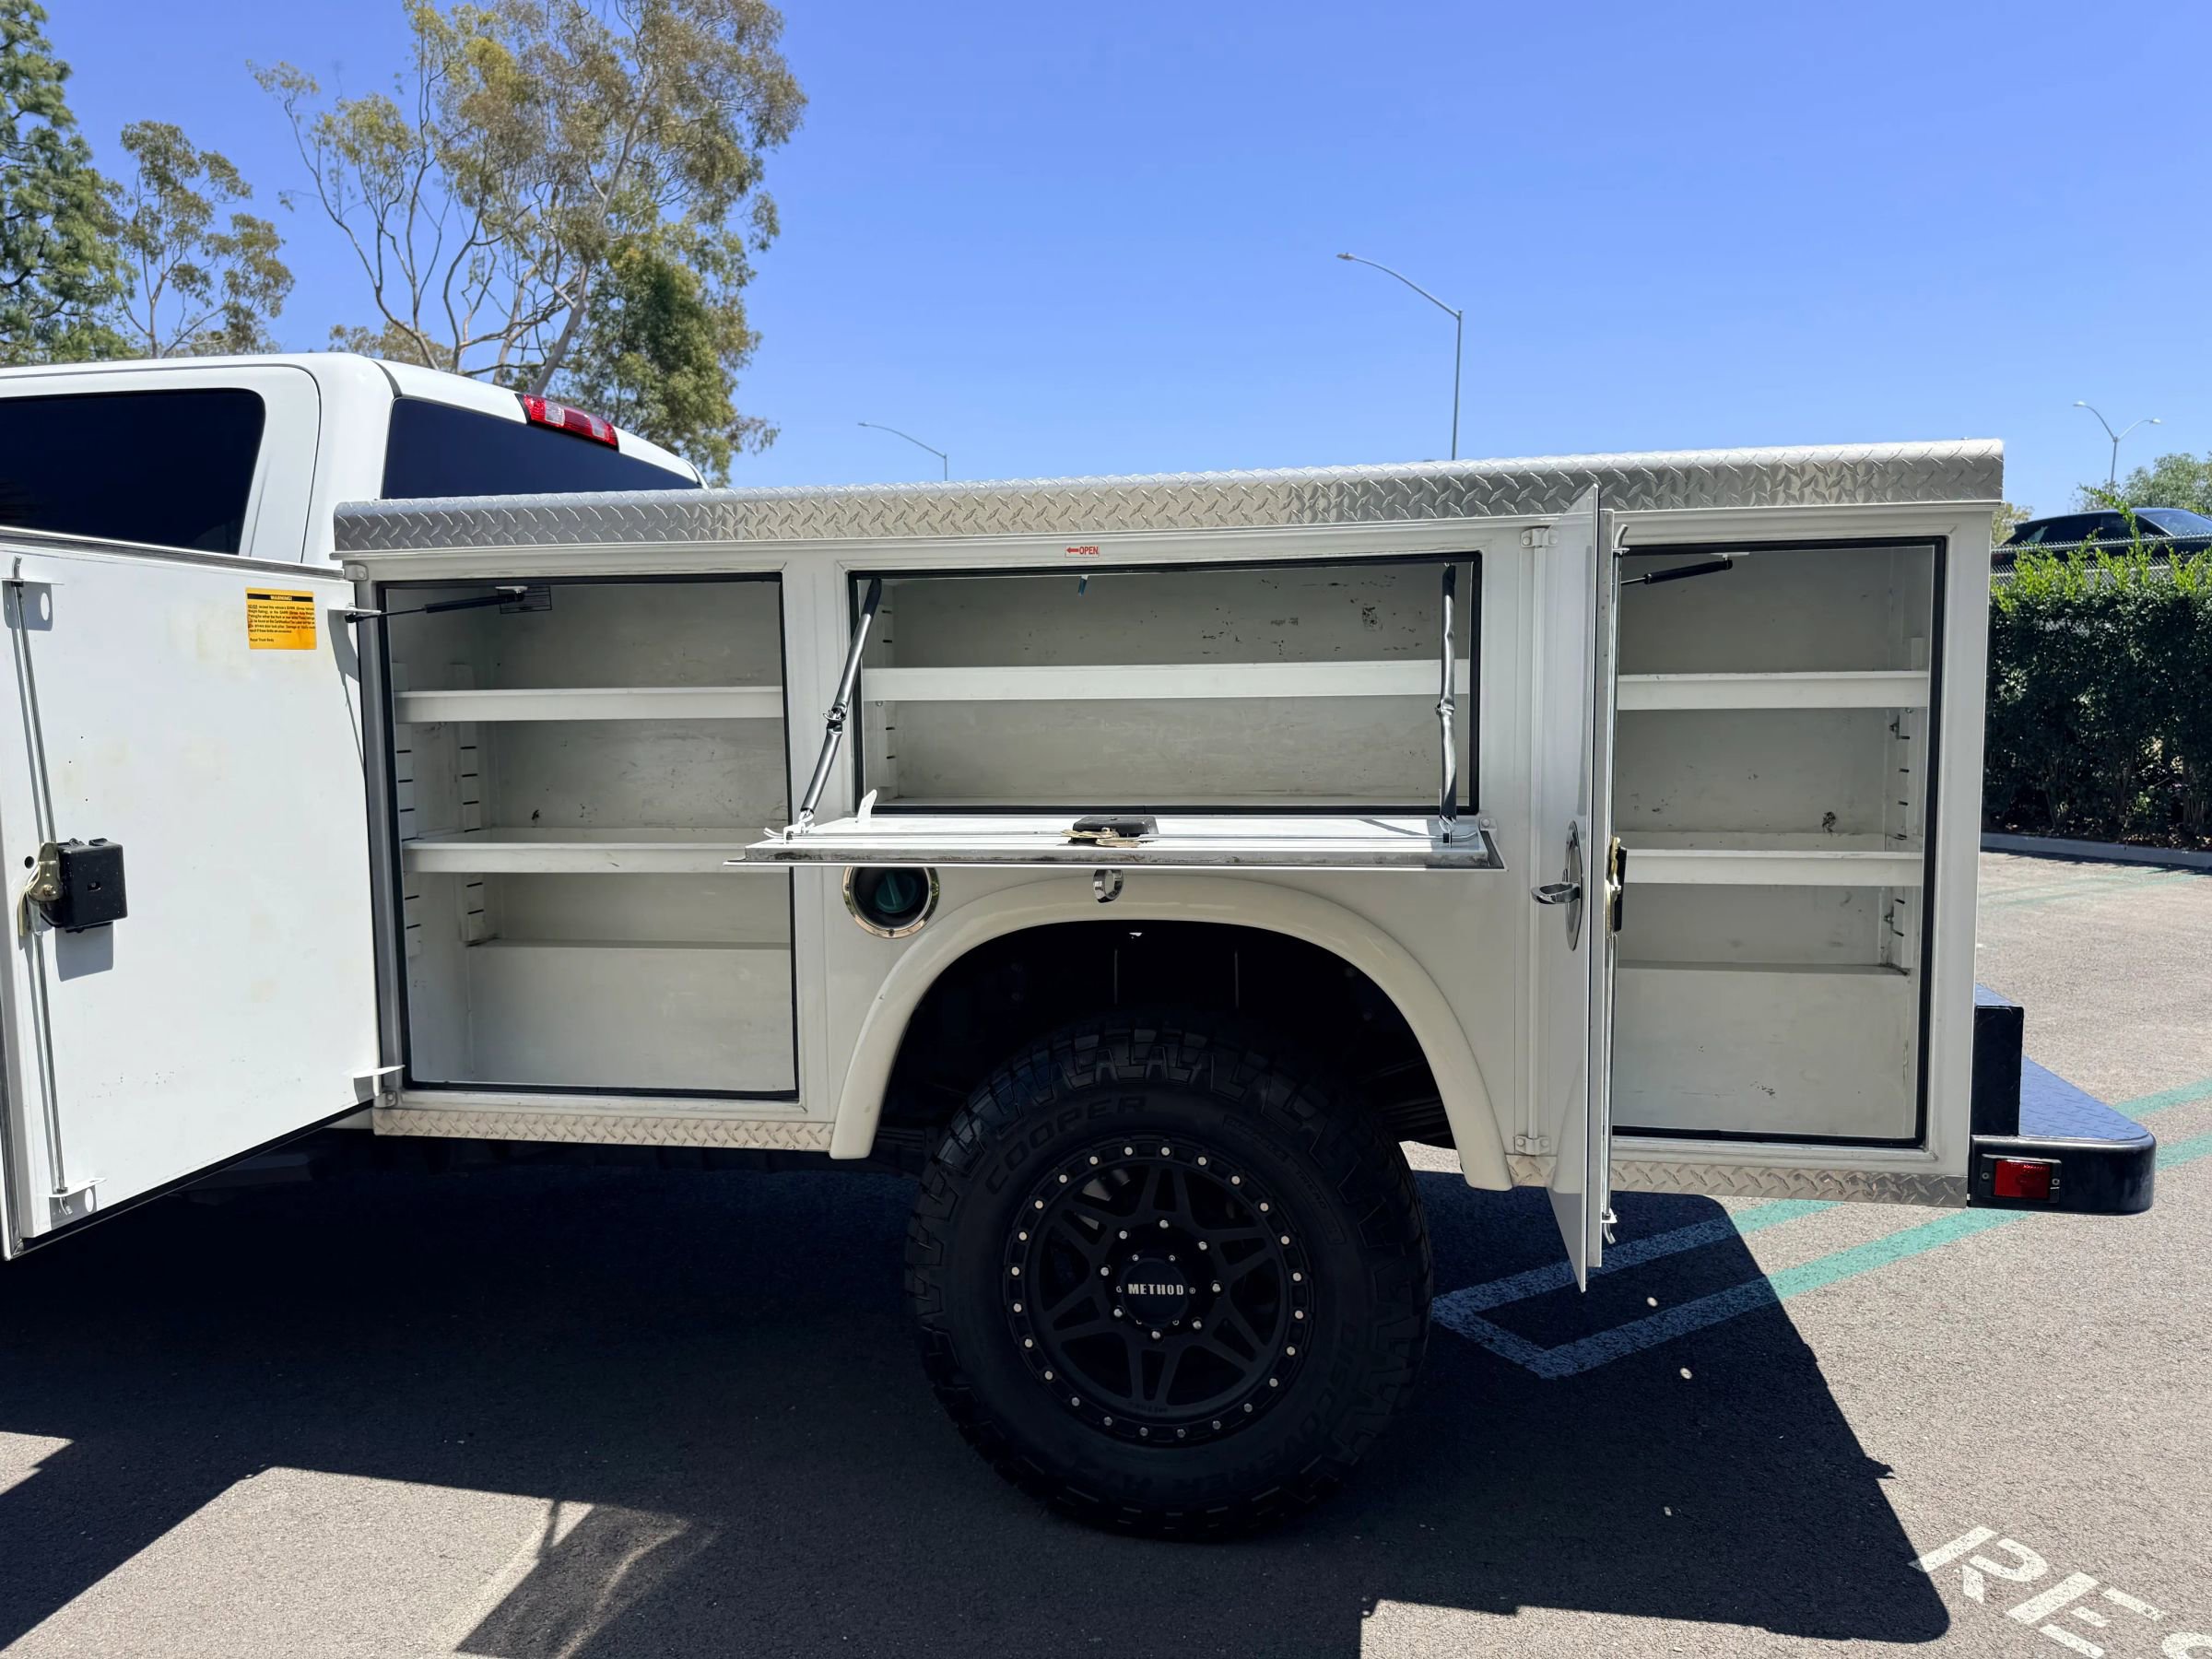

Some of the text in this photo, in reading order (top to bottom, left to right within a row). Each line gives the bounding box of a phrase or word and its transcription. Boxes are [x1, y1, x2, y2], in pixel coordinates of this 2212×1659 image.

[1079, 547, 1099, 555] OPEN
[985, 1095, 1147, 1194] COOPER
[1127, 1283, 1184, 1295] METHOD
